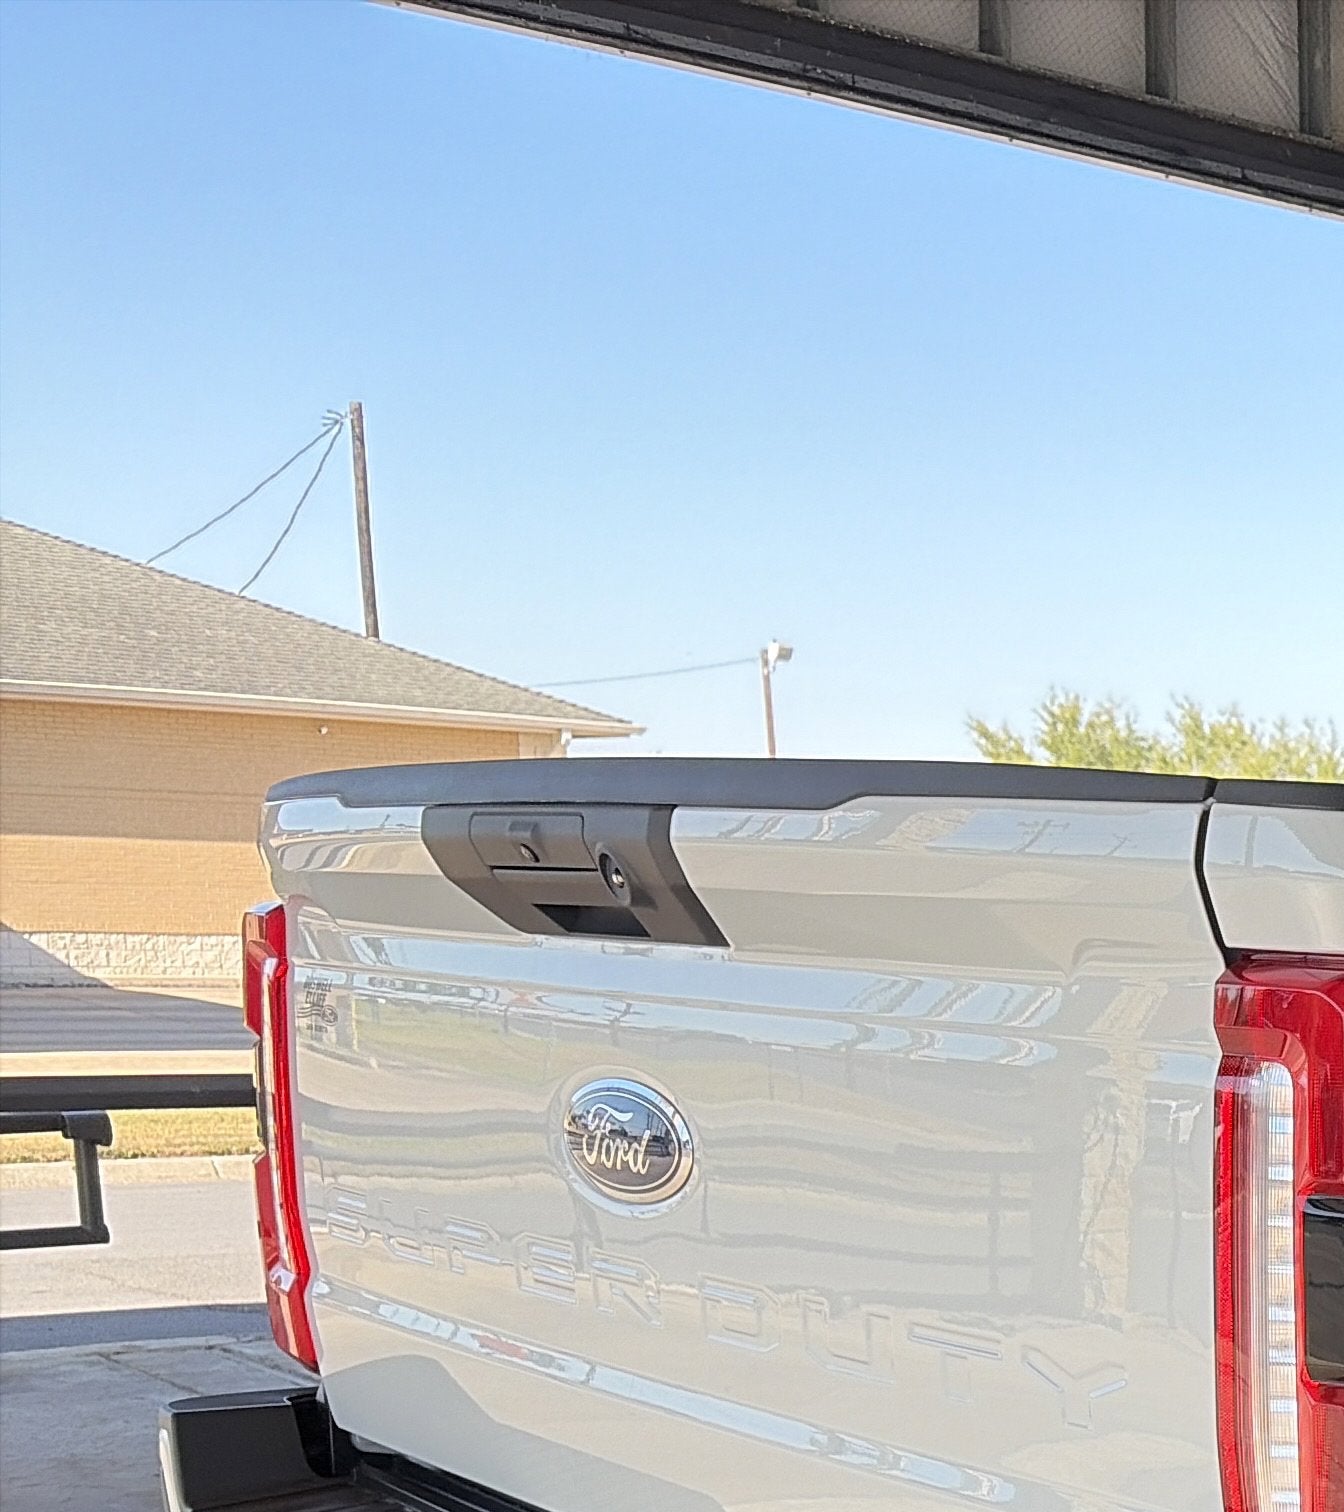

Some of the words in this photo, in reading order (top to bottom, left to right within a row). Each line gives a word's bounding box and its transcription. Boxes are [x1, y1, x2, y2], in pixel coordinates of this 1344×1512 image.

[582, 1103, 651, 1175] Ford
[326, 1186, 662, 1328] SUPER
[698, 1272, 1127, 1431] DUTY
